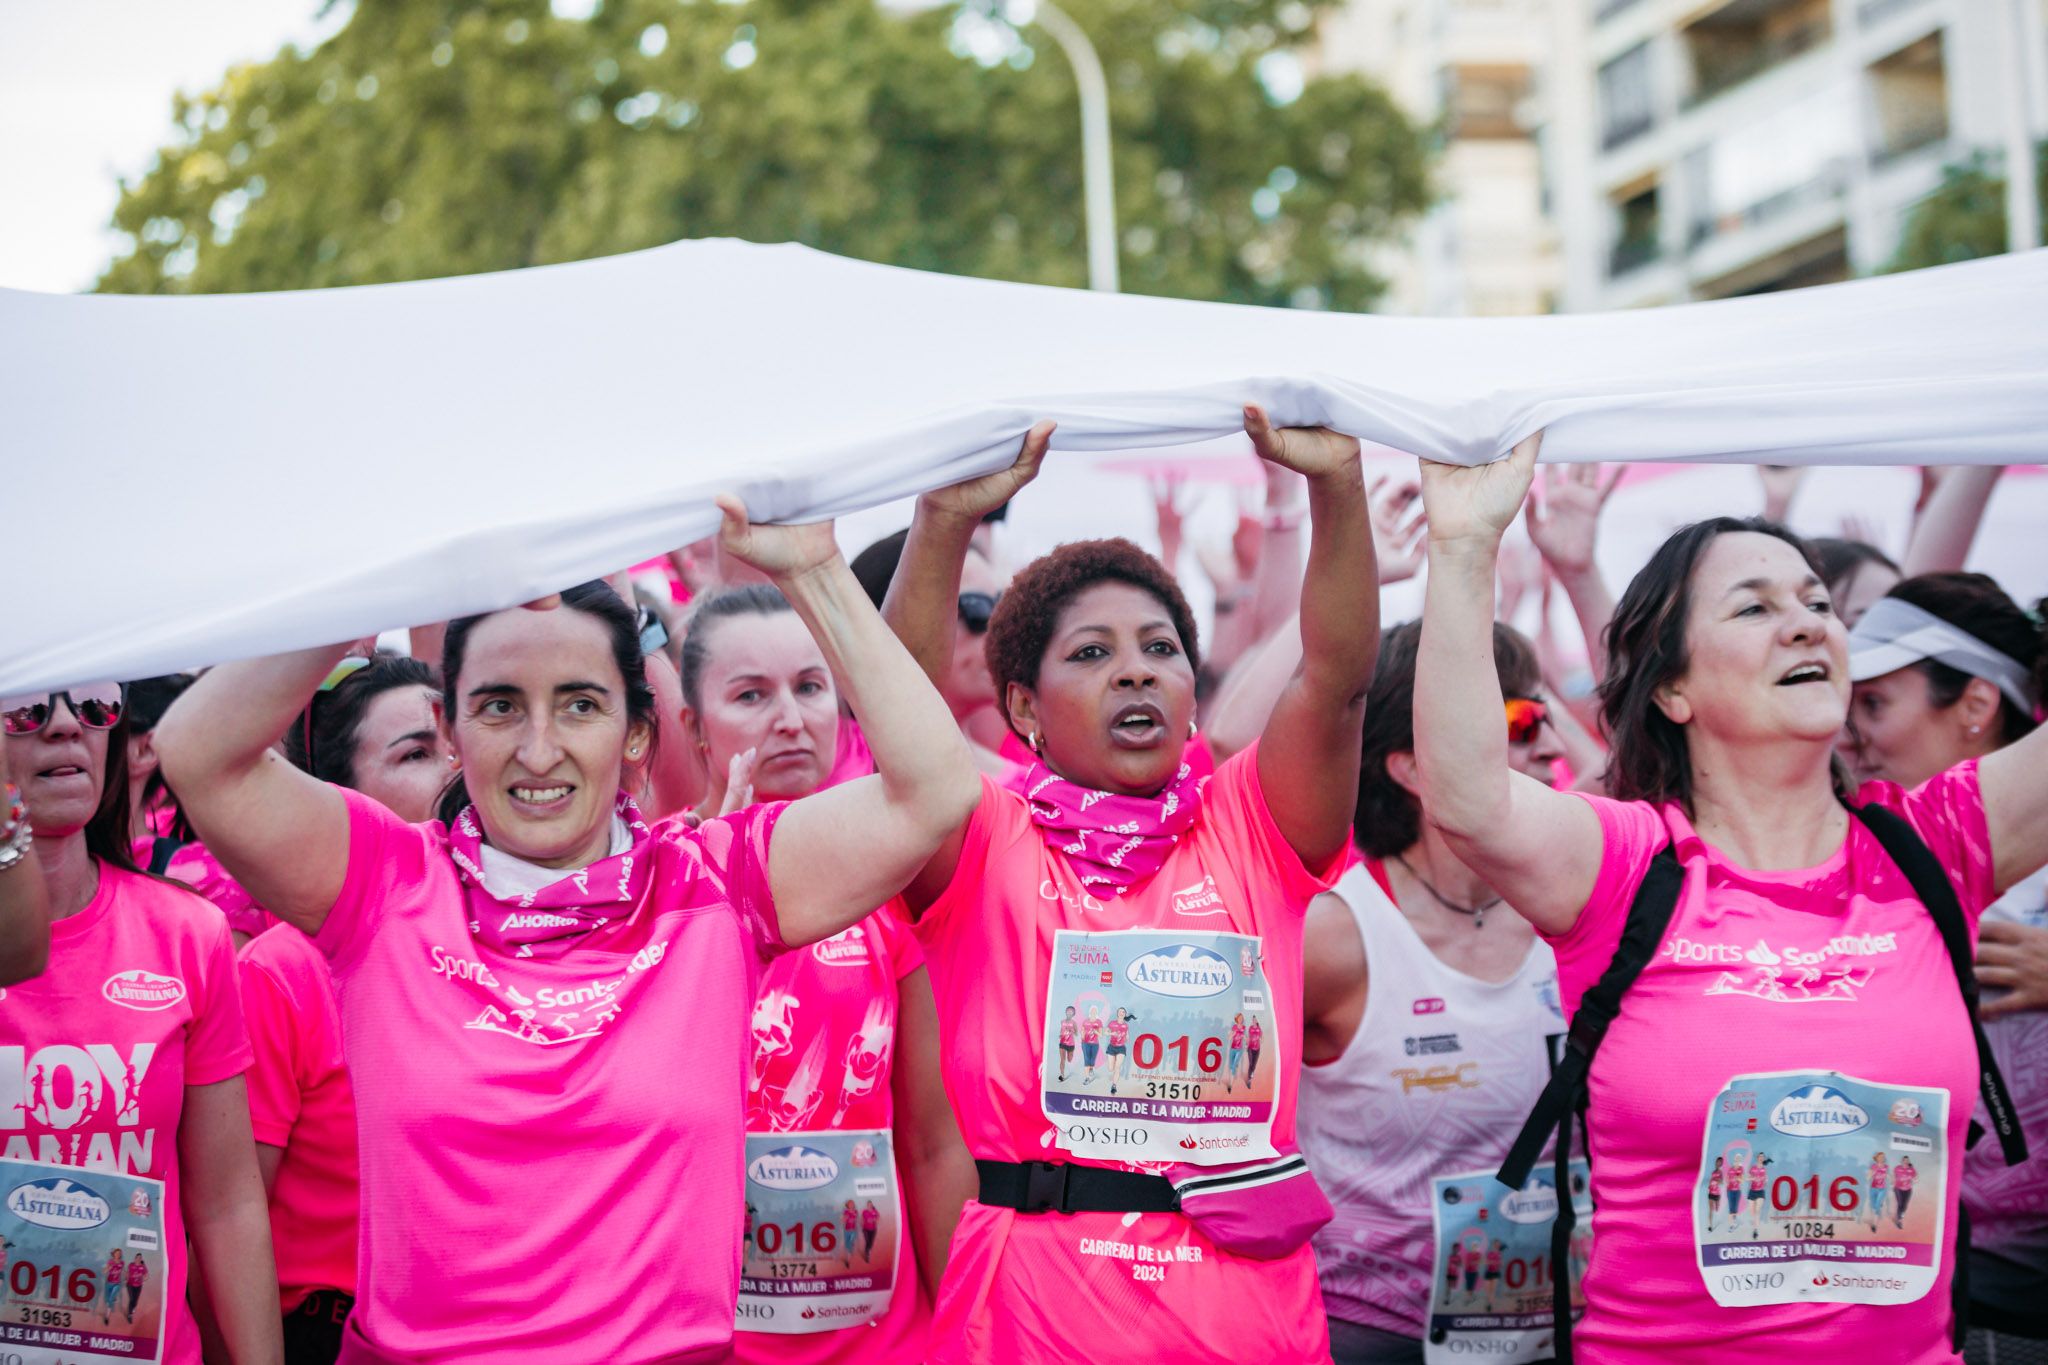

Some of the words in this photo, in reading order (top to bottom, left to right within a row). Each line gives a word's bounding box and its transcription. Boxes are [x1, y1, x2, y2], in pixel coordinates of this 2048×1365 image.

[431, 945, 500, 987] Sports
[1069, 952, 1110, 965] SUMA
[1134, 962, 1228, 986] ASTURIANA
[111, 982, 180, 1001] ASTURIANA
[1132, 1033, 1223, 1073] 016
[1146, 1082, 1201, 1101] 31510
[1072, 1098, 1128, 1113] CARRERA
[1132, 1103, 1148, 1115] DE
[1152, 1104, 1167, 1117] LA
[1171, 1105, 1206, 1118] MUJER
[1212, 1106, 1251, 1119] MADRID
[1775, 1108, 1861, 1126] ASTURIANA
[1068, 1125, 1148, 1146] OYSHO
[1199, 1134, 1250, 1150] Santander
[754, 1162, 834, 1180] ASTURIANA
[1771, 1174, 1860, 1212] 016
[13, 1191, 103, 1222] ASTURIANA
[756, 1222, 837, 1254] 016
[1784, 1222, 1835, 1239] 10284
[1080, 1238, 1135, 1260] CARRERA
[1137, 1245, 1154, 1262] DE
[1157, 1249, 1174, 1262] LA
[1719, 1247, 1769, 1260] CARRERA
[1772, 1245, 1787, 1258] DE
[1789, 1245, 1801, 1257] LA
[1802, 1243, 1846, 1258] MUJER
[1856, 1246, 1907, 1259] MADRID
[770, 1262, 817, 1278] 13774
[1132, 1264, 1165, 1281] 2024
[10, 1260, 97, 1303] 016
[760, 1282, 774, 1293] DE
[775, 1282, 790, 1293] LA
[792, 1281, 827, 1293] MUJER
[834, 1277, 873, 1290] MADRID
[1722, 1271, 1785, 1293] OYSHO
[1832, 1274, 1908, 1291] Santander
[20, 1307, 72, 1328] 31963
[817, 1303, 872, 1319] Santander
[8, 1327, 23, 1340] DE
[25, 1329, 40, 1341] LA
[43, 1331, 82, 1346] MUJER
[89, 1337, 134, 1352] MADRID
[1447, 1339, 1518, 1354] OYSHO
